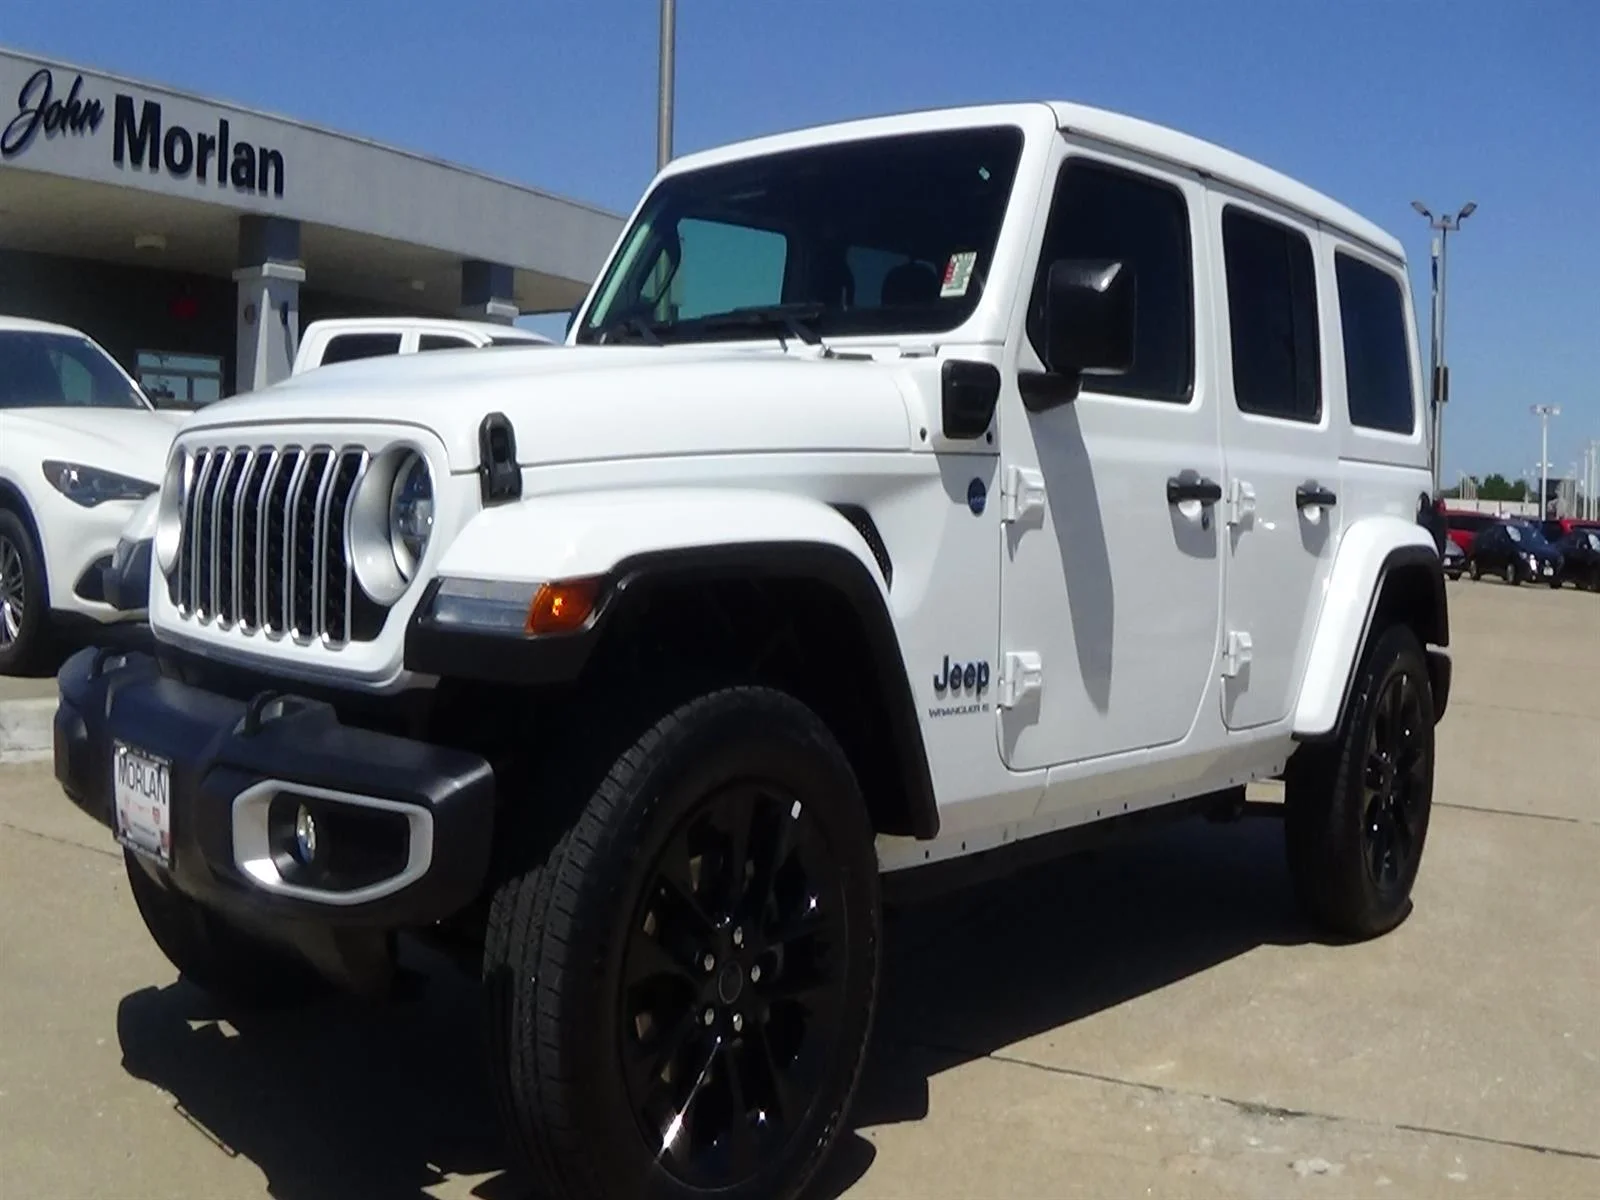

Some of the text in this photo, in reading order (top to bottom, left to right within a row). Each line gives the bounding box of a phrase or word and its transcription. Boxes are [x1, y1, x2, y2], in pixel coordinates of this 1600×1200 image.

[1, 69, 284, 197] John Morlan
[933, 654, 990, 695] Jeep
[119, 755, 167, 805] MORLAN
